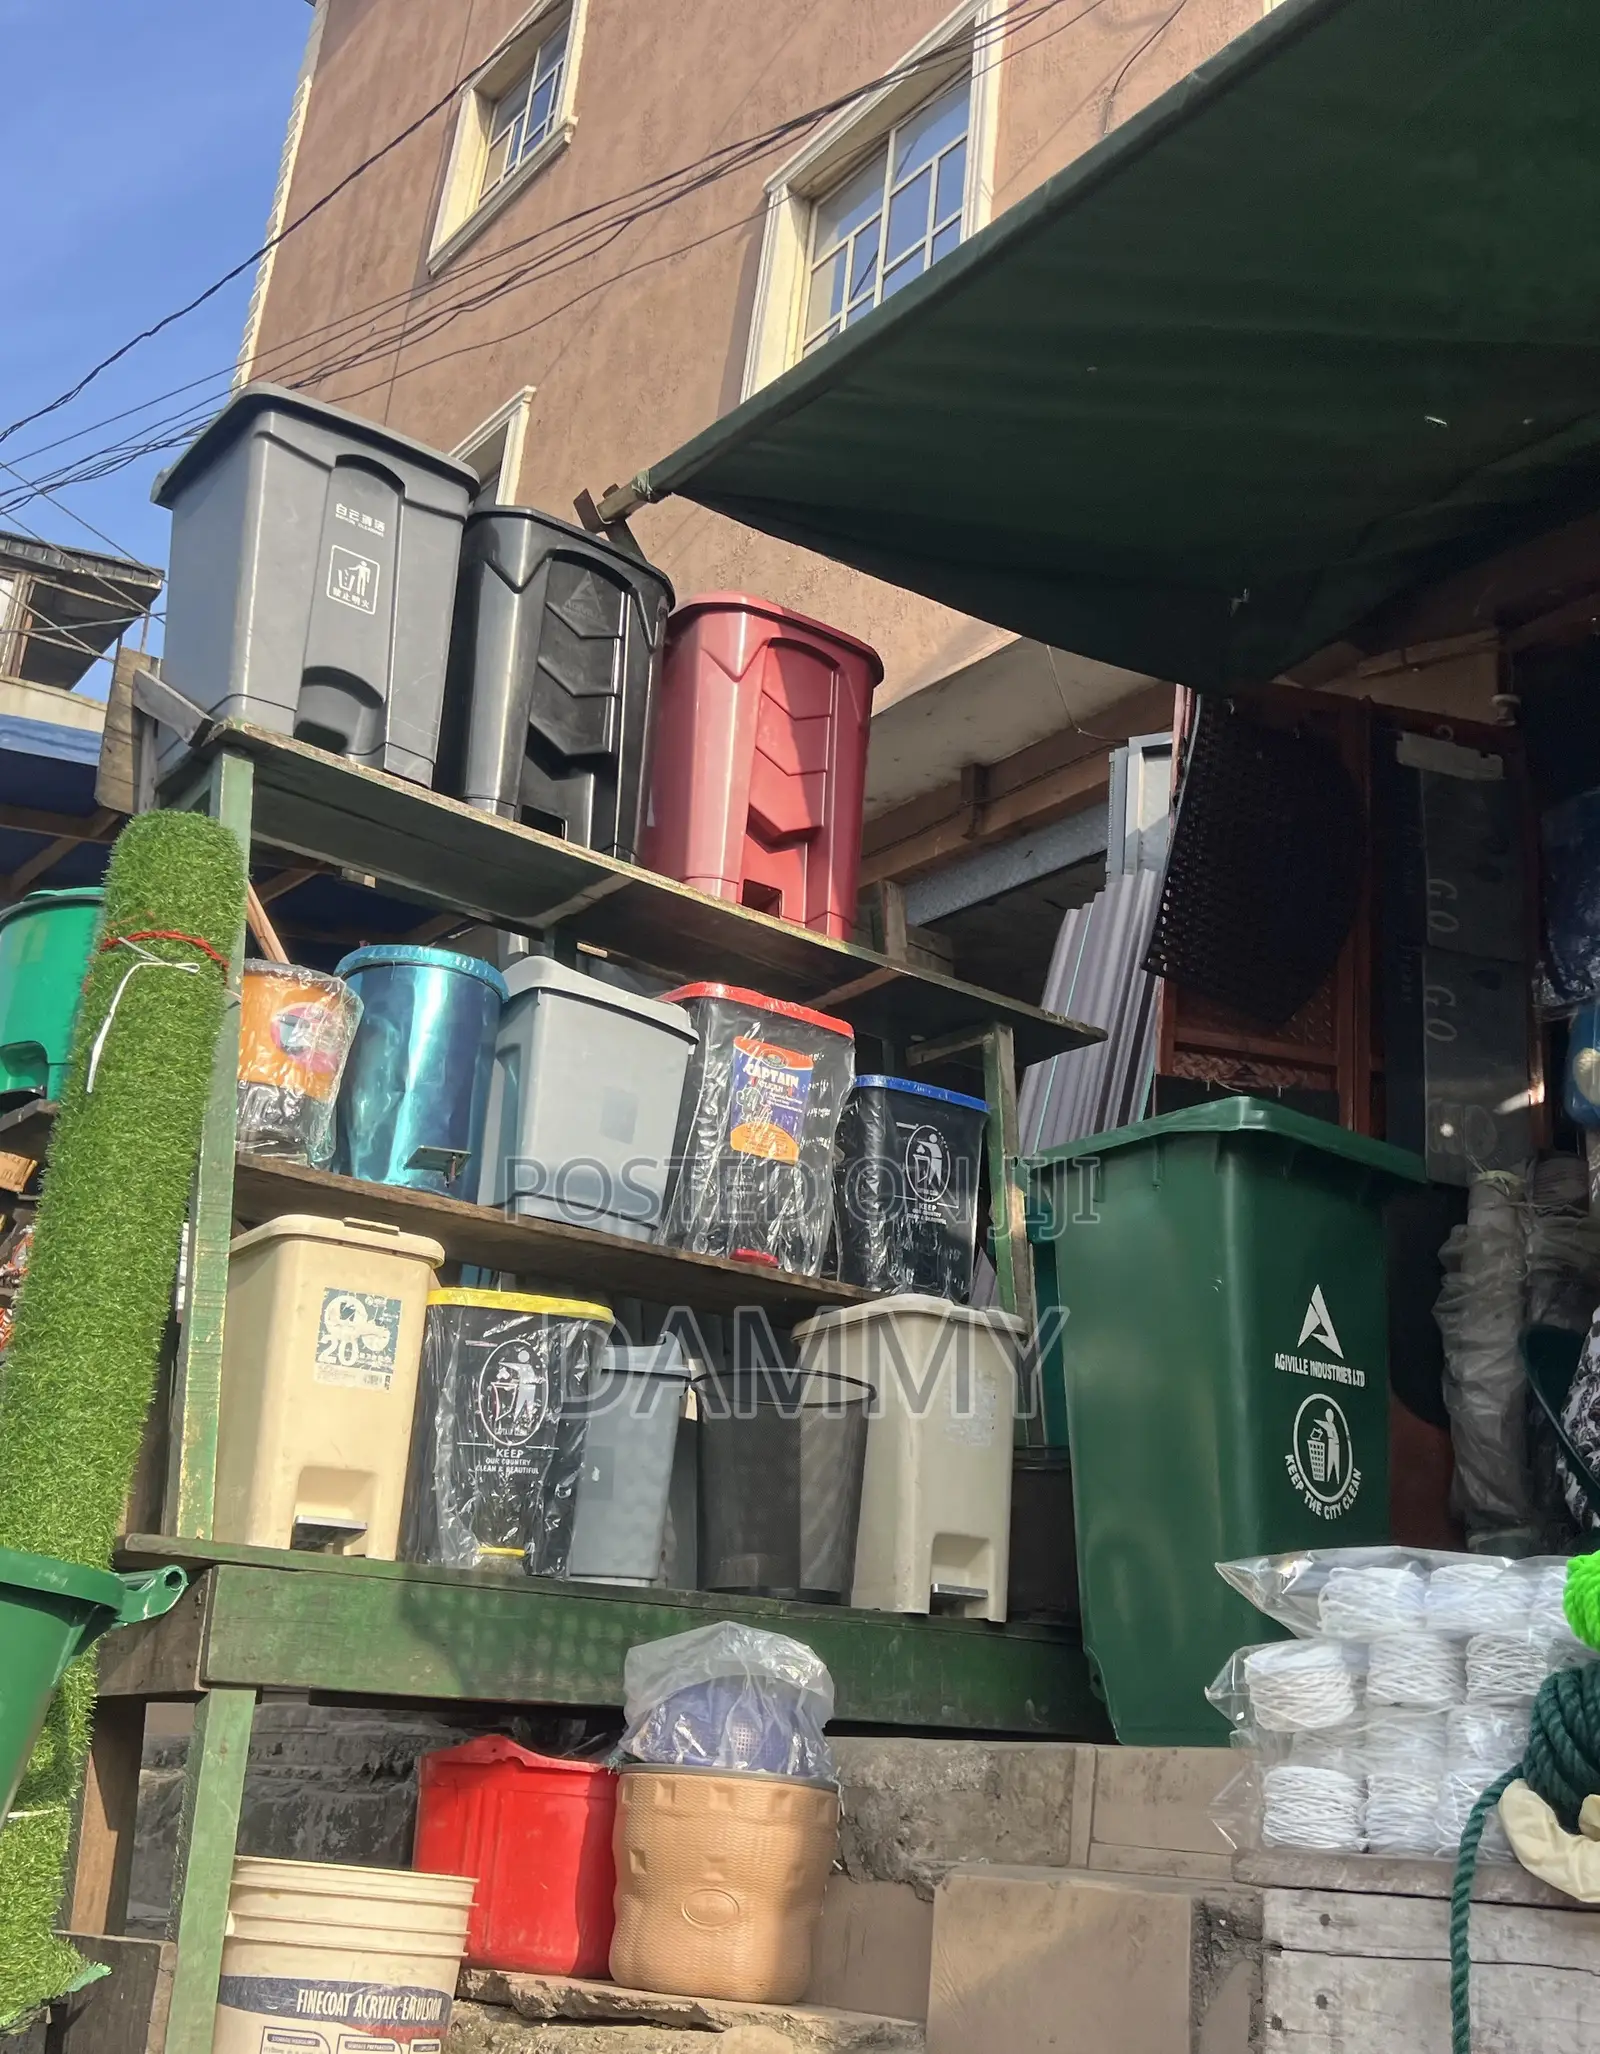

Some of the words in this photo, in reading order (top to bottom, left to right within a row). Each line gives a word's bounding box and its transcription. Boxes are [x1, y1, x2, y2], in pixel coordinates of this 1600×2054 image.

[744, 1062, 799, 1088] CAPTAIN
[918, 1202, 937, 1212] KEEP
[317, 1334, 360, 1366] 20
[1274, 1352, 1309, 1376] AGIVILLE
[1309, 1359, 1352, 1385] INDUSTRIES
[1352, 1368, 1366, 1388] LTD
[495, 1448, 524, 1459] KEEP
[501, 1458, 532, 1466] COUNTRY
[475, 1465, 497, 1473] CLEAN
[505, 1465, 539, 1475] BEAUTIFUL
[1284, 1453, 1304, 1491] KEEP
[1304, 1490, 1322, 1517] THE
[1323, 1501, 1343, 1520] CITY
[1342, 1467, 1362, 1511] CLEAN
[296, 1988, 353, 2017] FINECOAT
[353, 1993, 399, 2020] ACRYLIC
[400, 1995, 443, 2021] EMULSION
